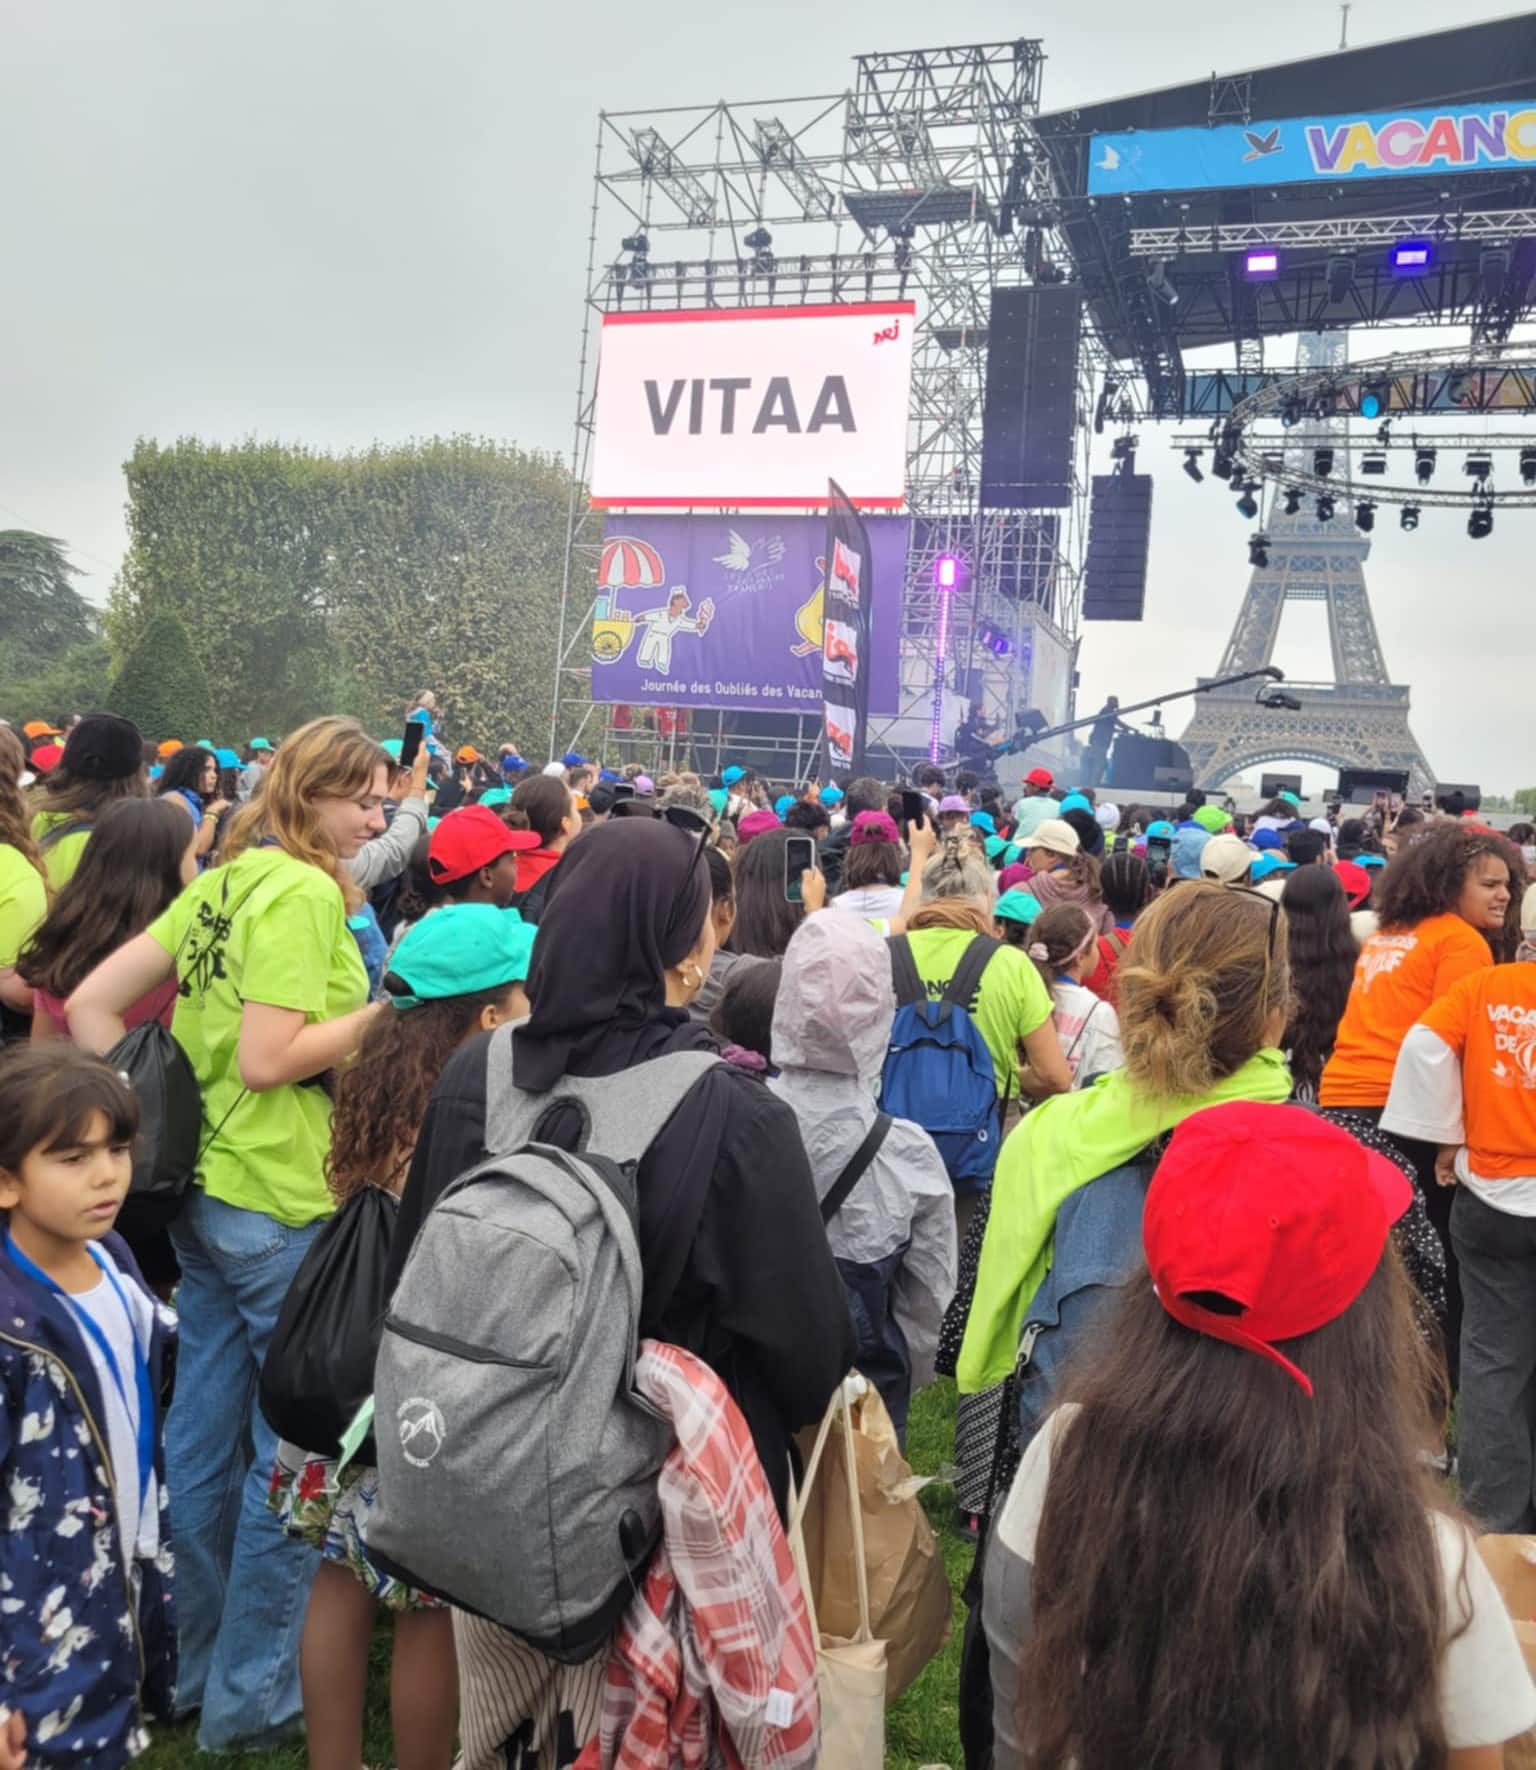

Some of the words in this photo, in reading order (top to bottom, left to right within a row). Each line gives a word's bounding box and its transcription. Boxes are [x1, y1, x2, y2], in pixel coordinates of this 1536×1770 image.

[643, 374, 857, 436] VITAA
[640, 679, 687, 694] Journée
[690, 682, 711, 695] des
[714, 681, 758, 696] Oubliés
[761, 684, 783, 698] des
